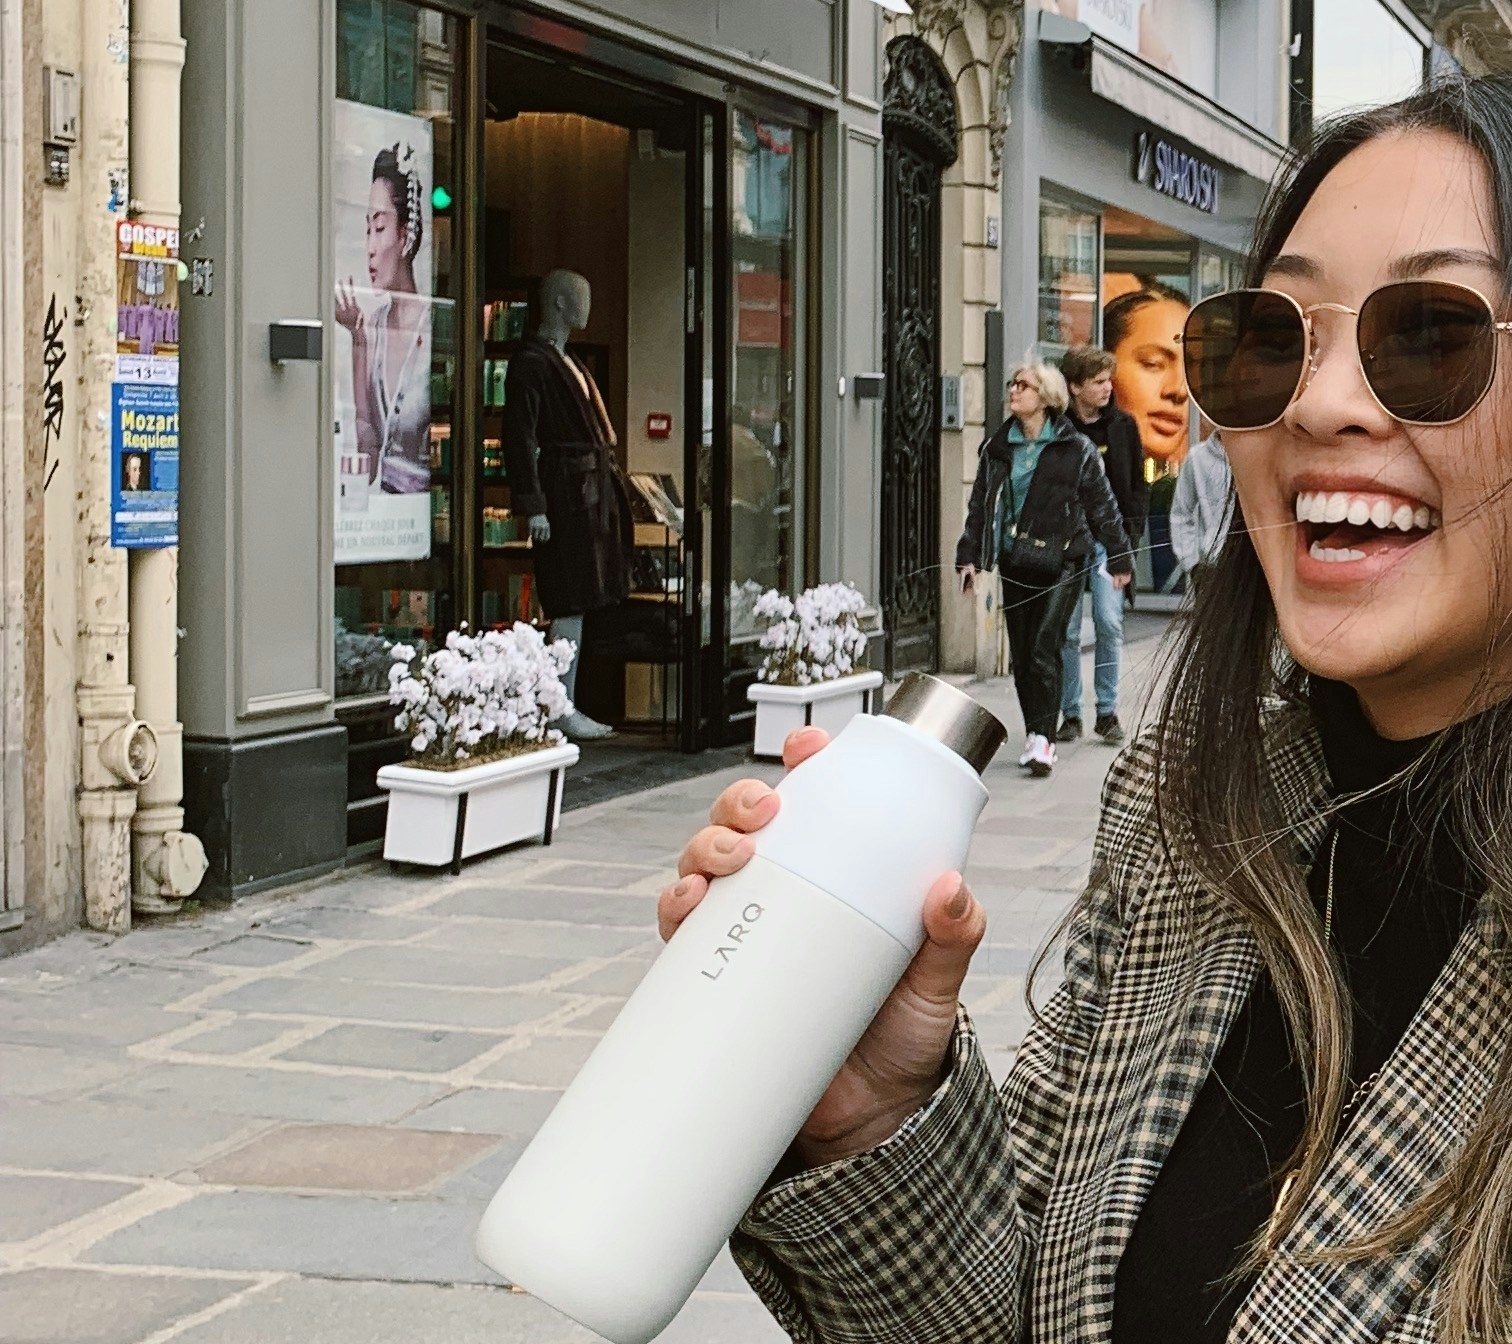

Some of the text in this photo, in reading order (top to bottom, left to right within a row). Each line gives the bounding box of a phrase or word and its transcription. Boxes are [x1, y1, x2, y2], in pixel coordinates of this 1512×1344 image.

[1154, 139, 1219, 215] SWAROVSKI
[120, 408, 180, 433] Mozart
[122, 430, 179, 453] Requiem
[701, 902, 766, 981] LARQ
